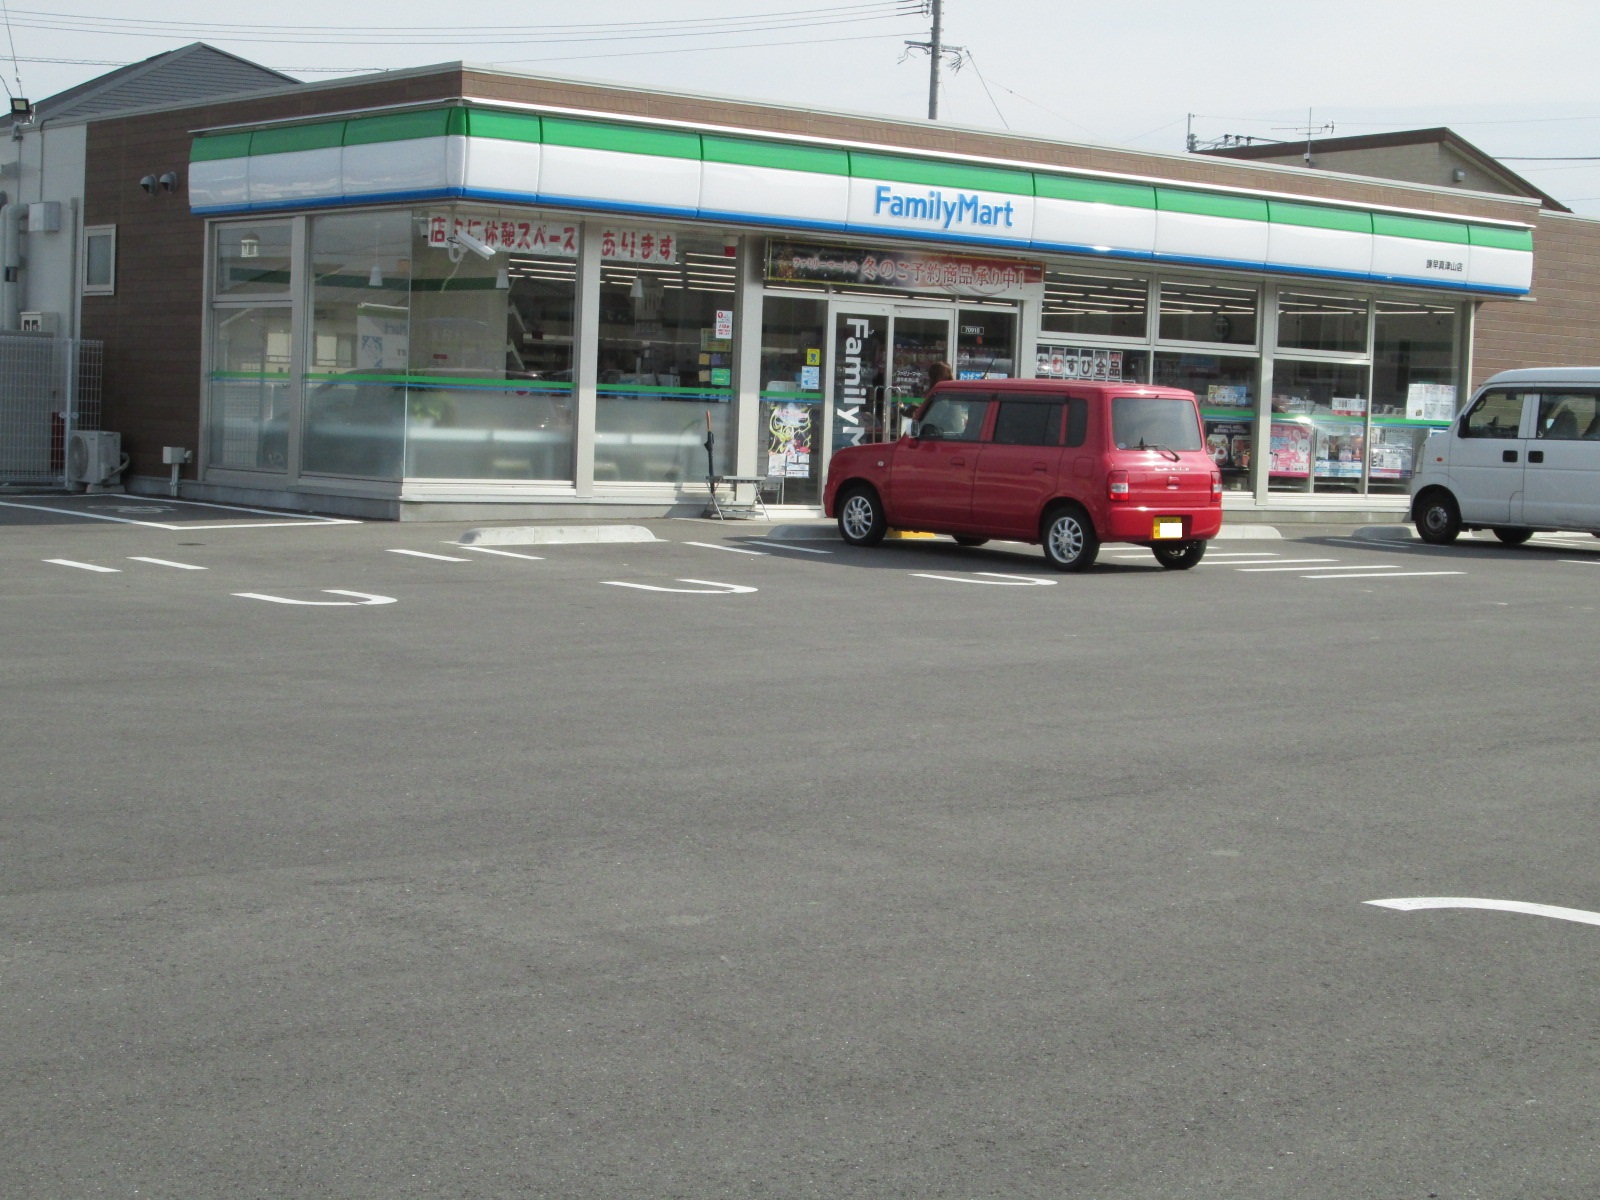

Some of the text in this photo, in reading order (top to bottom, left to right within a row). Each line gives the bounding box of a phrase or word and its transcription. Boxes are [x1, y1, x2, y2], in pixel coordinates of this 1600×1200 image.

[875, 185, 1014, 229] FamilyMart
[601, 229, 673, 261] あります
[792, 257, 858, 272] ファミリーマートの
